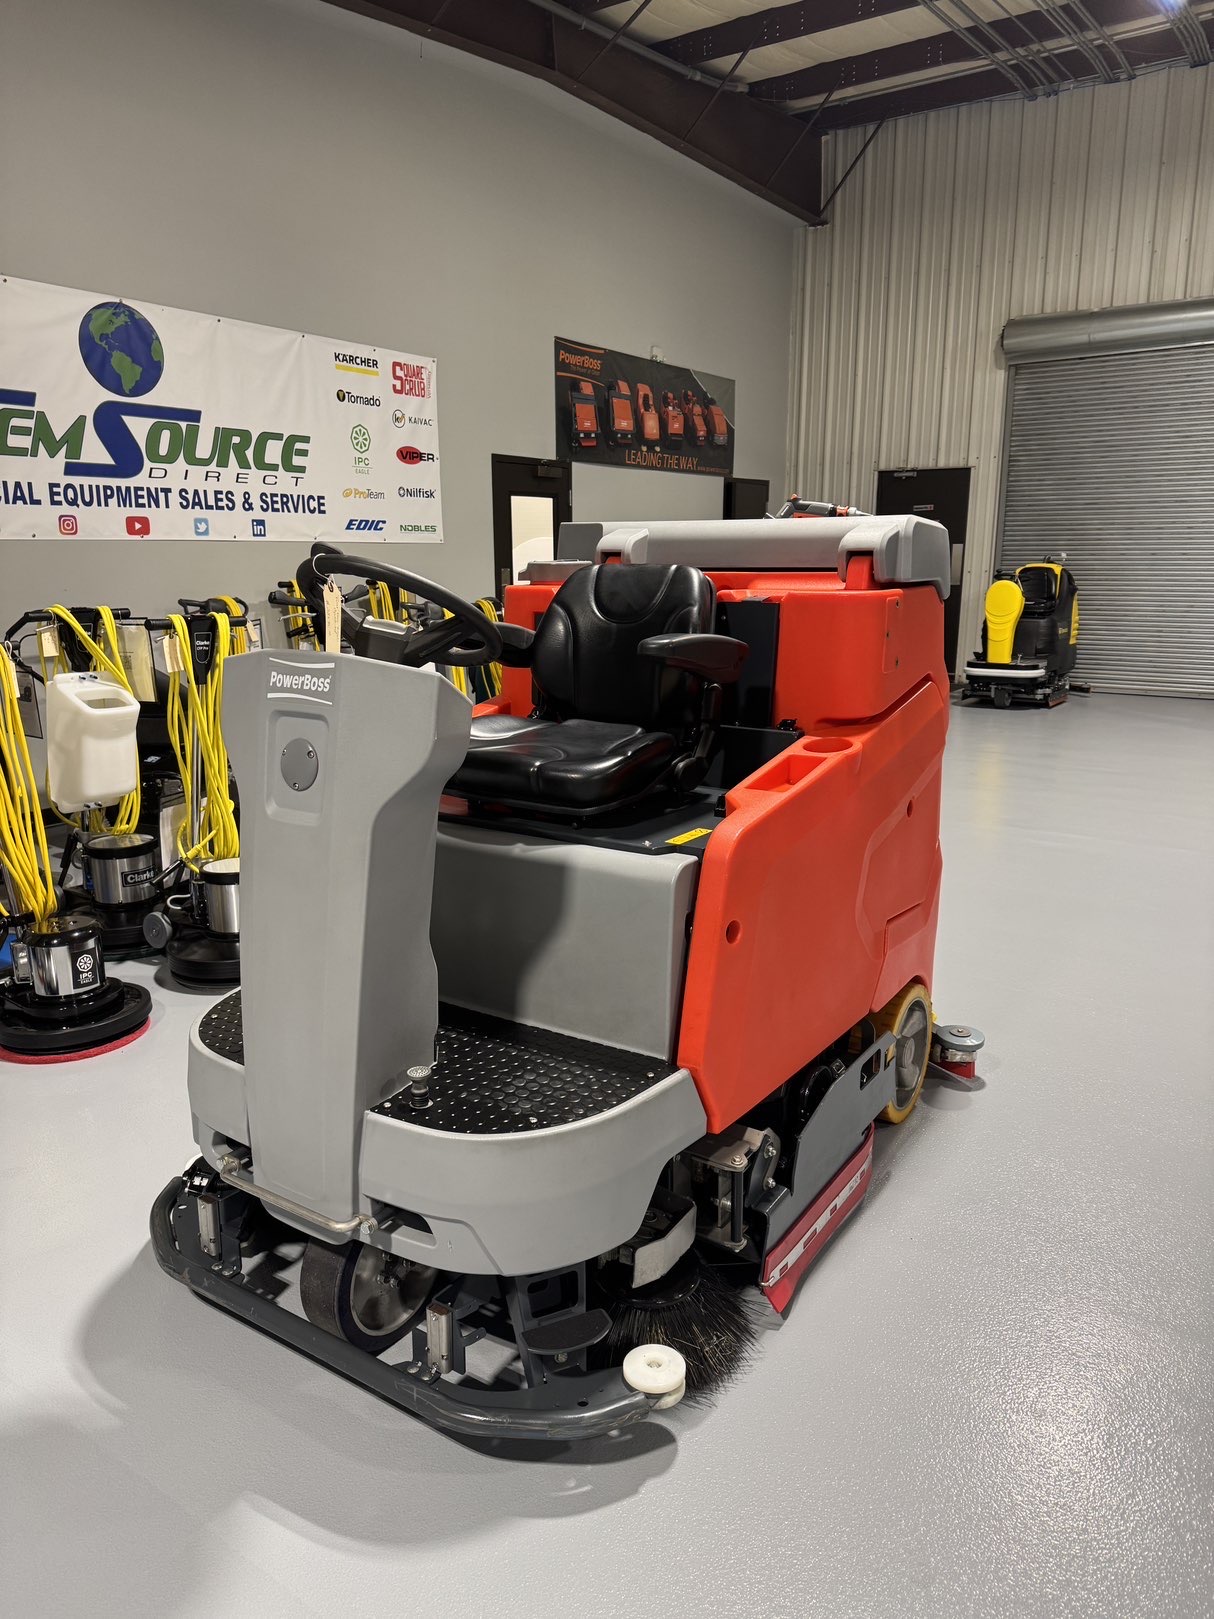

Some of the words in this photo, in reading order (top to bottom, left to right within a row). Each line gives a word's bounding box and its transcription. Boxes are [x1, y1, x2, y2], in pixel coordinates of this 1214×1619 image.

[334, 351, 379, 369] KÄRCHER
[559, 350, 602, 370] PowerBoss
[345, 391, 381, 408] Tornado
[408, 416, 433, 427] KAIVAC
[354, 456, 370, 466] IPC
[400, 450, 435, 463] VIPER
[625, 449, 662, 468] LEADING
[663, 454, 679, 469] THE
[148, 467, 304, 487] DIRECT
[0, 480, 42, 506] IAL
[48, 482, 172, 509] EQUIPMENT
[178, 487, 236, 512] SALES
[242, 491, 254, 512] &
[260, 491, 327, 514] SERVICE
[353, 487, 385, 500] ProTeam
[405, 487, 436, 499] Nilfisk
[345, 518, 387, 532] EDIC
[399, 524, 437, 533] NOBLES
[269, 671, 332, 693] PowerBoss
[79, 971, 93, 980] IPC
